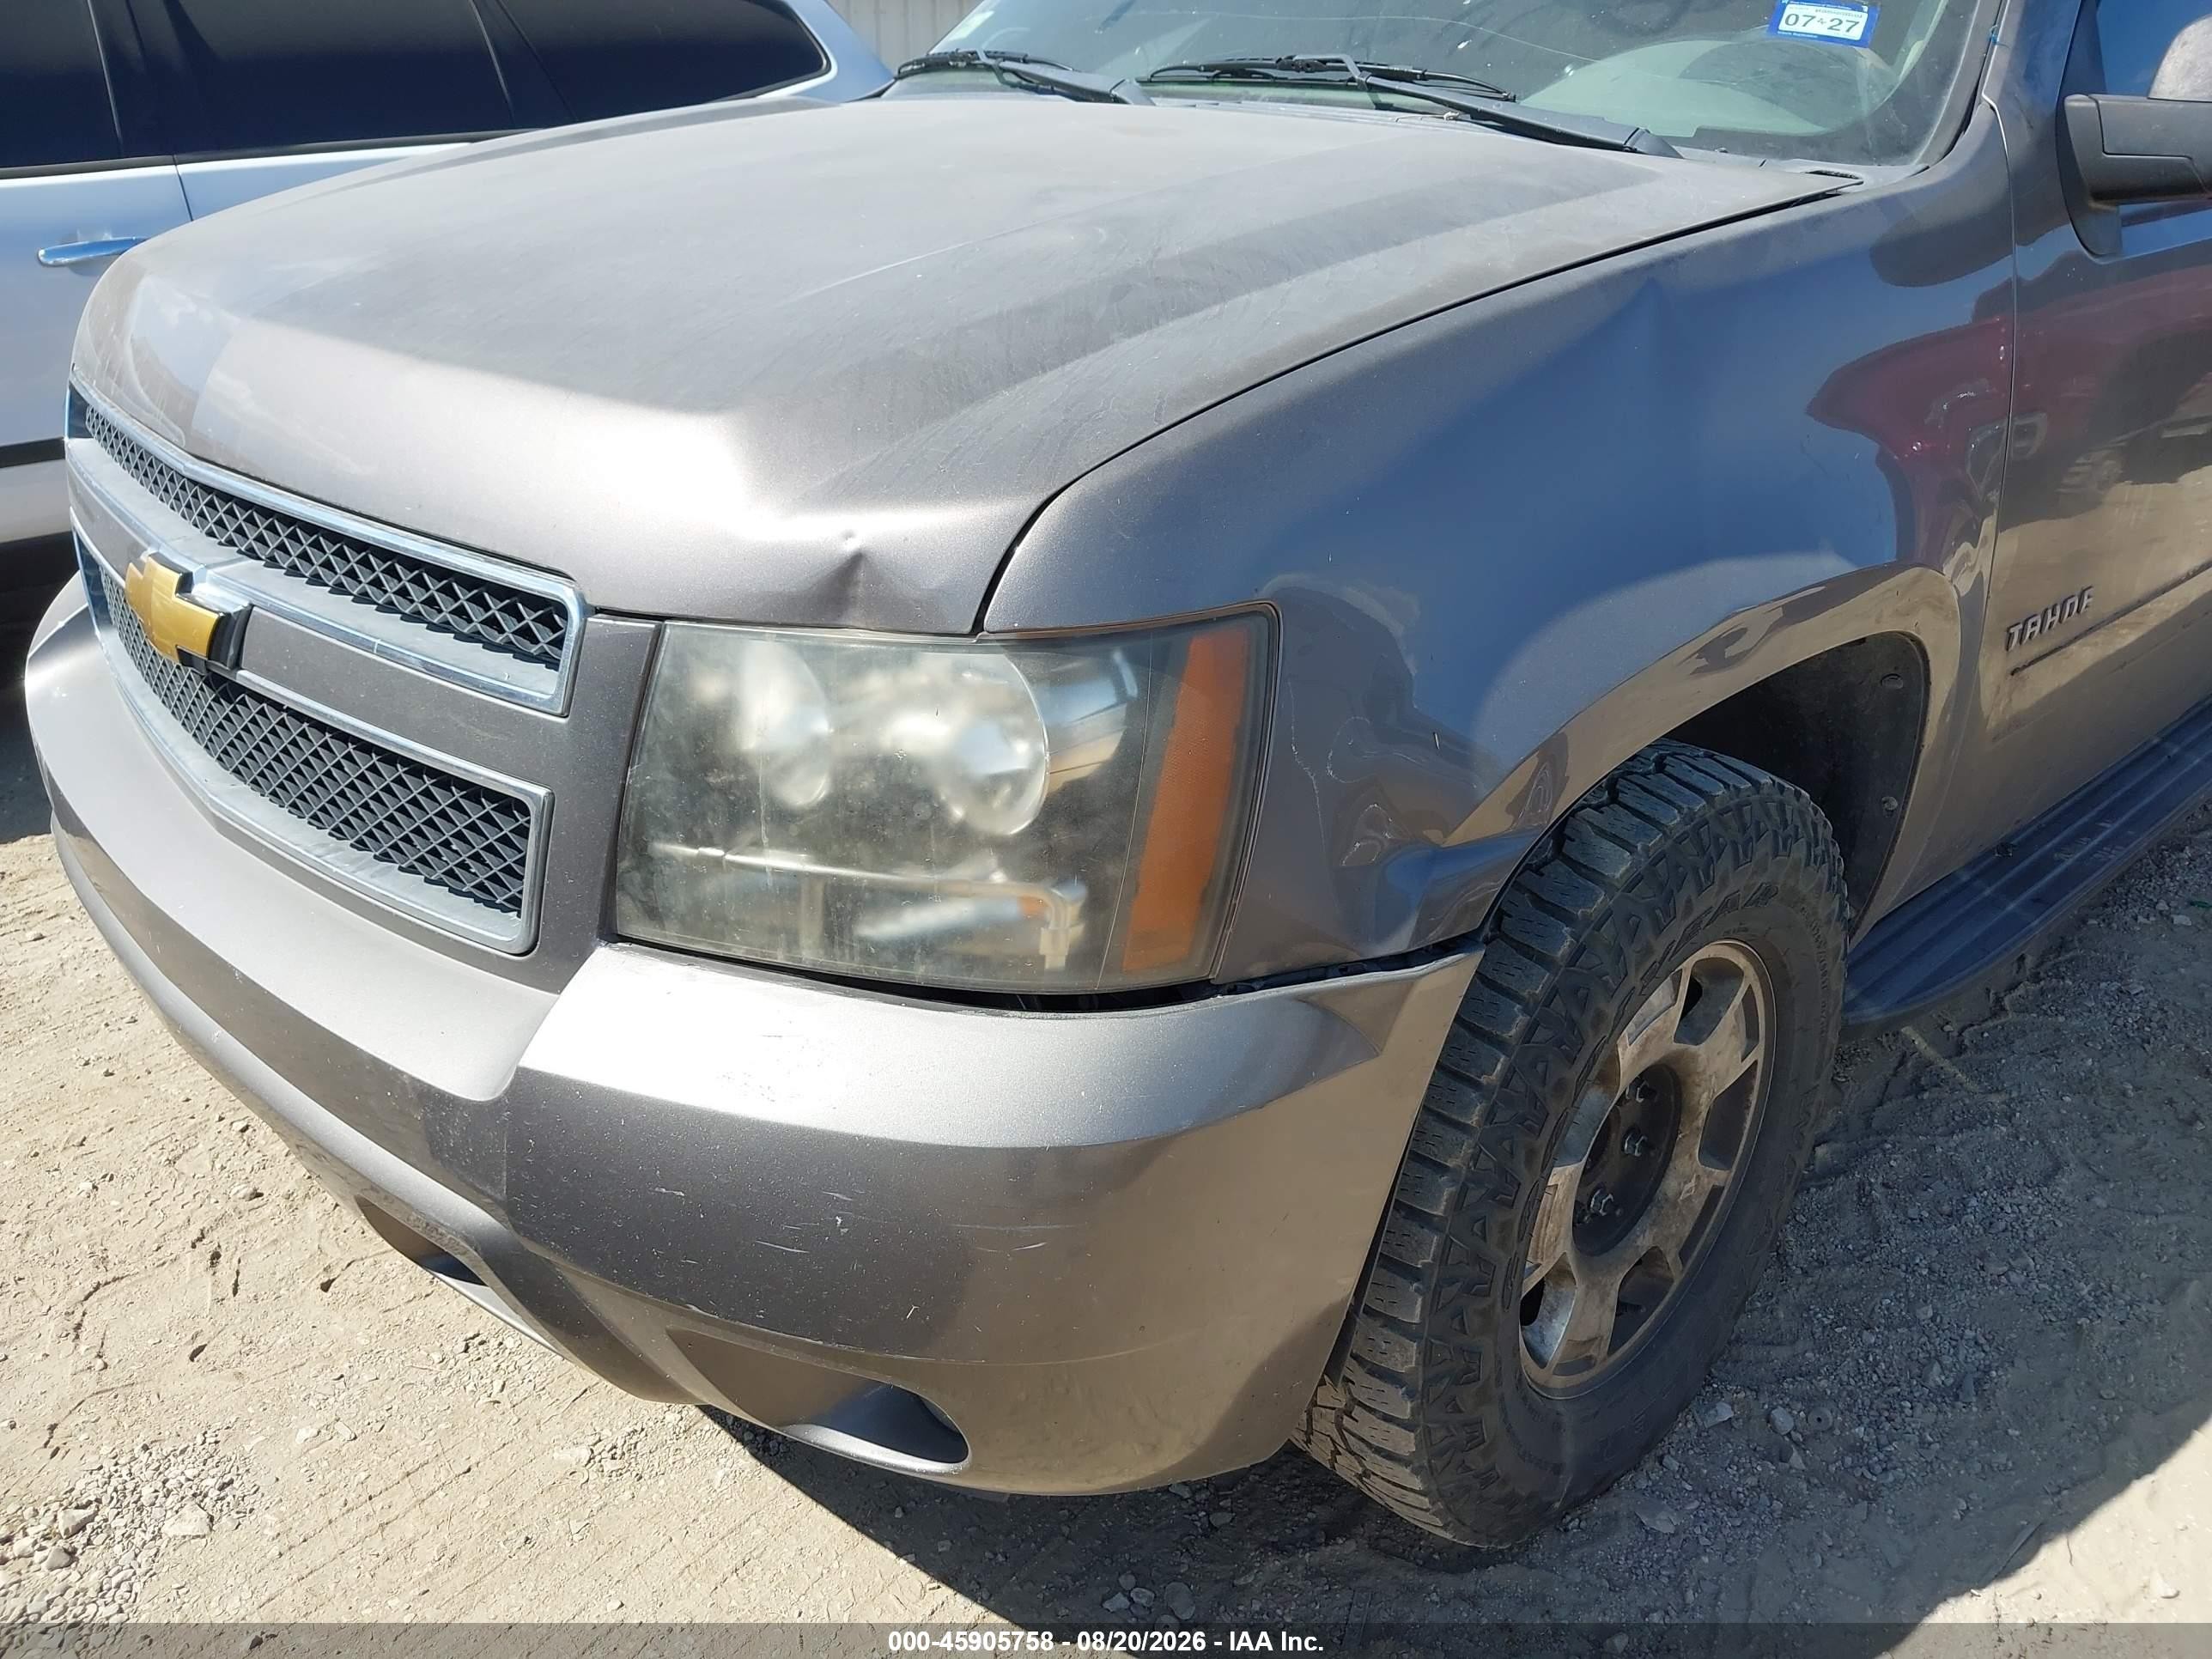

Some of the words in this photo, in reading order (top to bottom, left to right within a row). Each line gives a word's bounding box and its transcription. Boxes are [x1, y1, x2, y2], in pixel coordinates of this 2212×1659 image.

[1784, 13, 1816, 27] 07
[1826, 17, 1860, 33] 27
[2005, 585, 2094, 652] TAHOE
